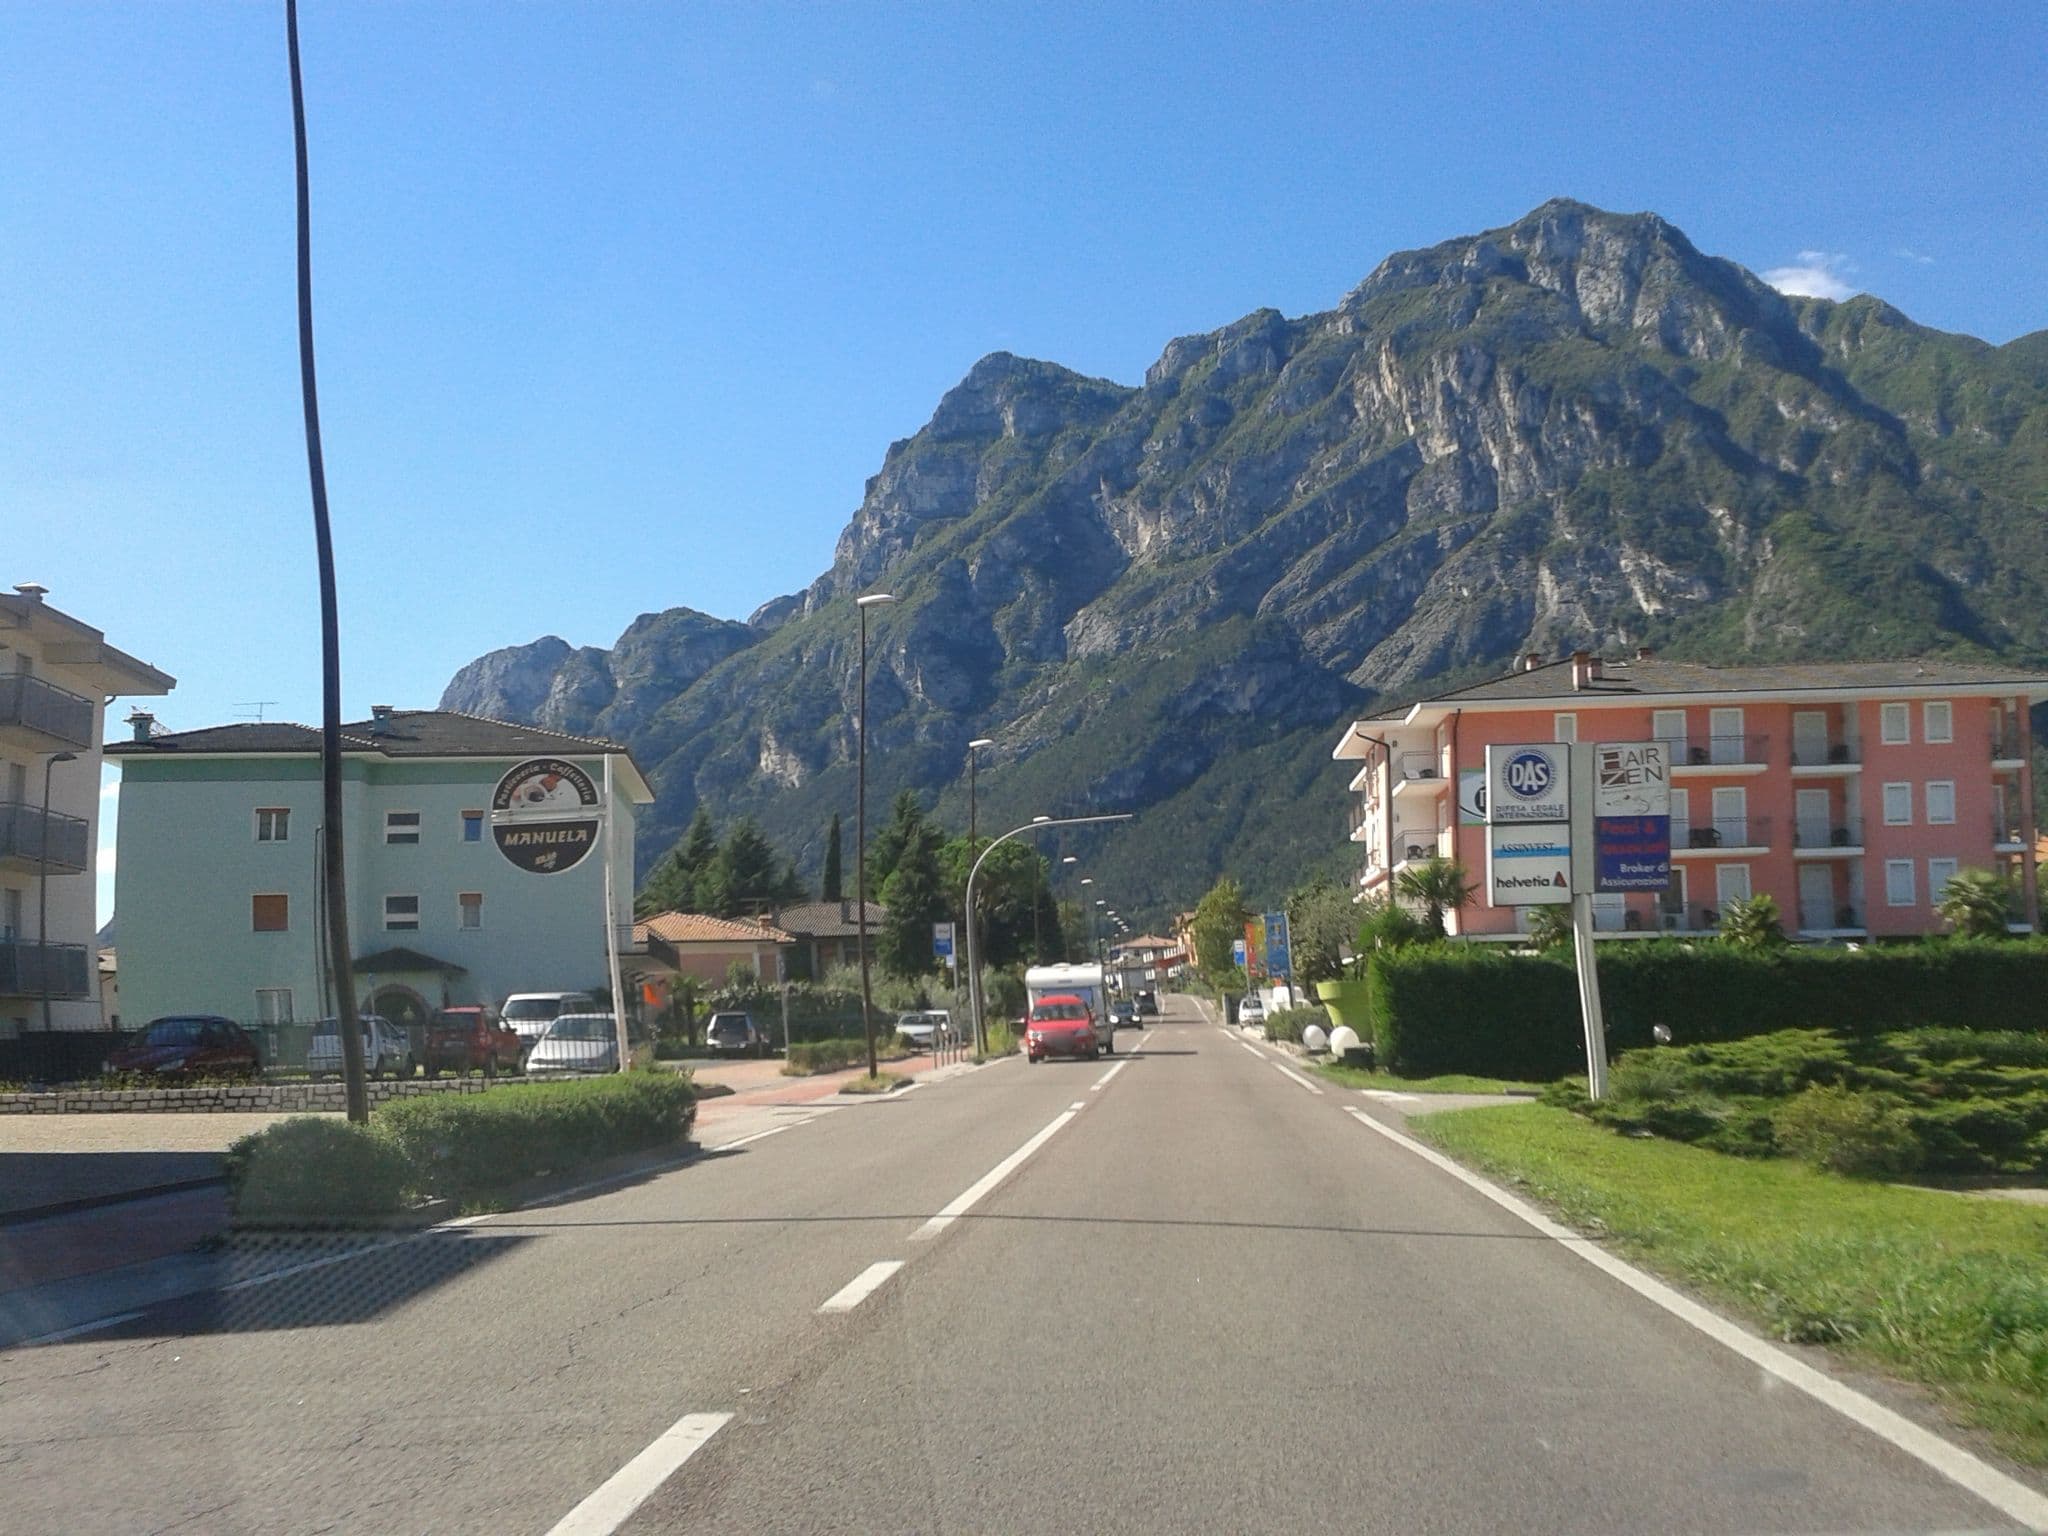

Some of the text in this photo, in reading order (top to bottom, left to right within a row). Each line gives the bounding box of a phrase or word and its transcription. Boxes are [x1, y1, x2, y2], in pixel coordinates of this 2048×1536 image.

[1511, 760, 1548, 791] DAS
[1600, 766, 1664, 789] ZEN
[504, 829, 588, 846] MANUELA
[1620, 863, 1656, 873] Broker
[1496, 876, 1550, 888] helvetia
